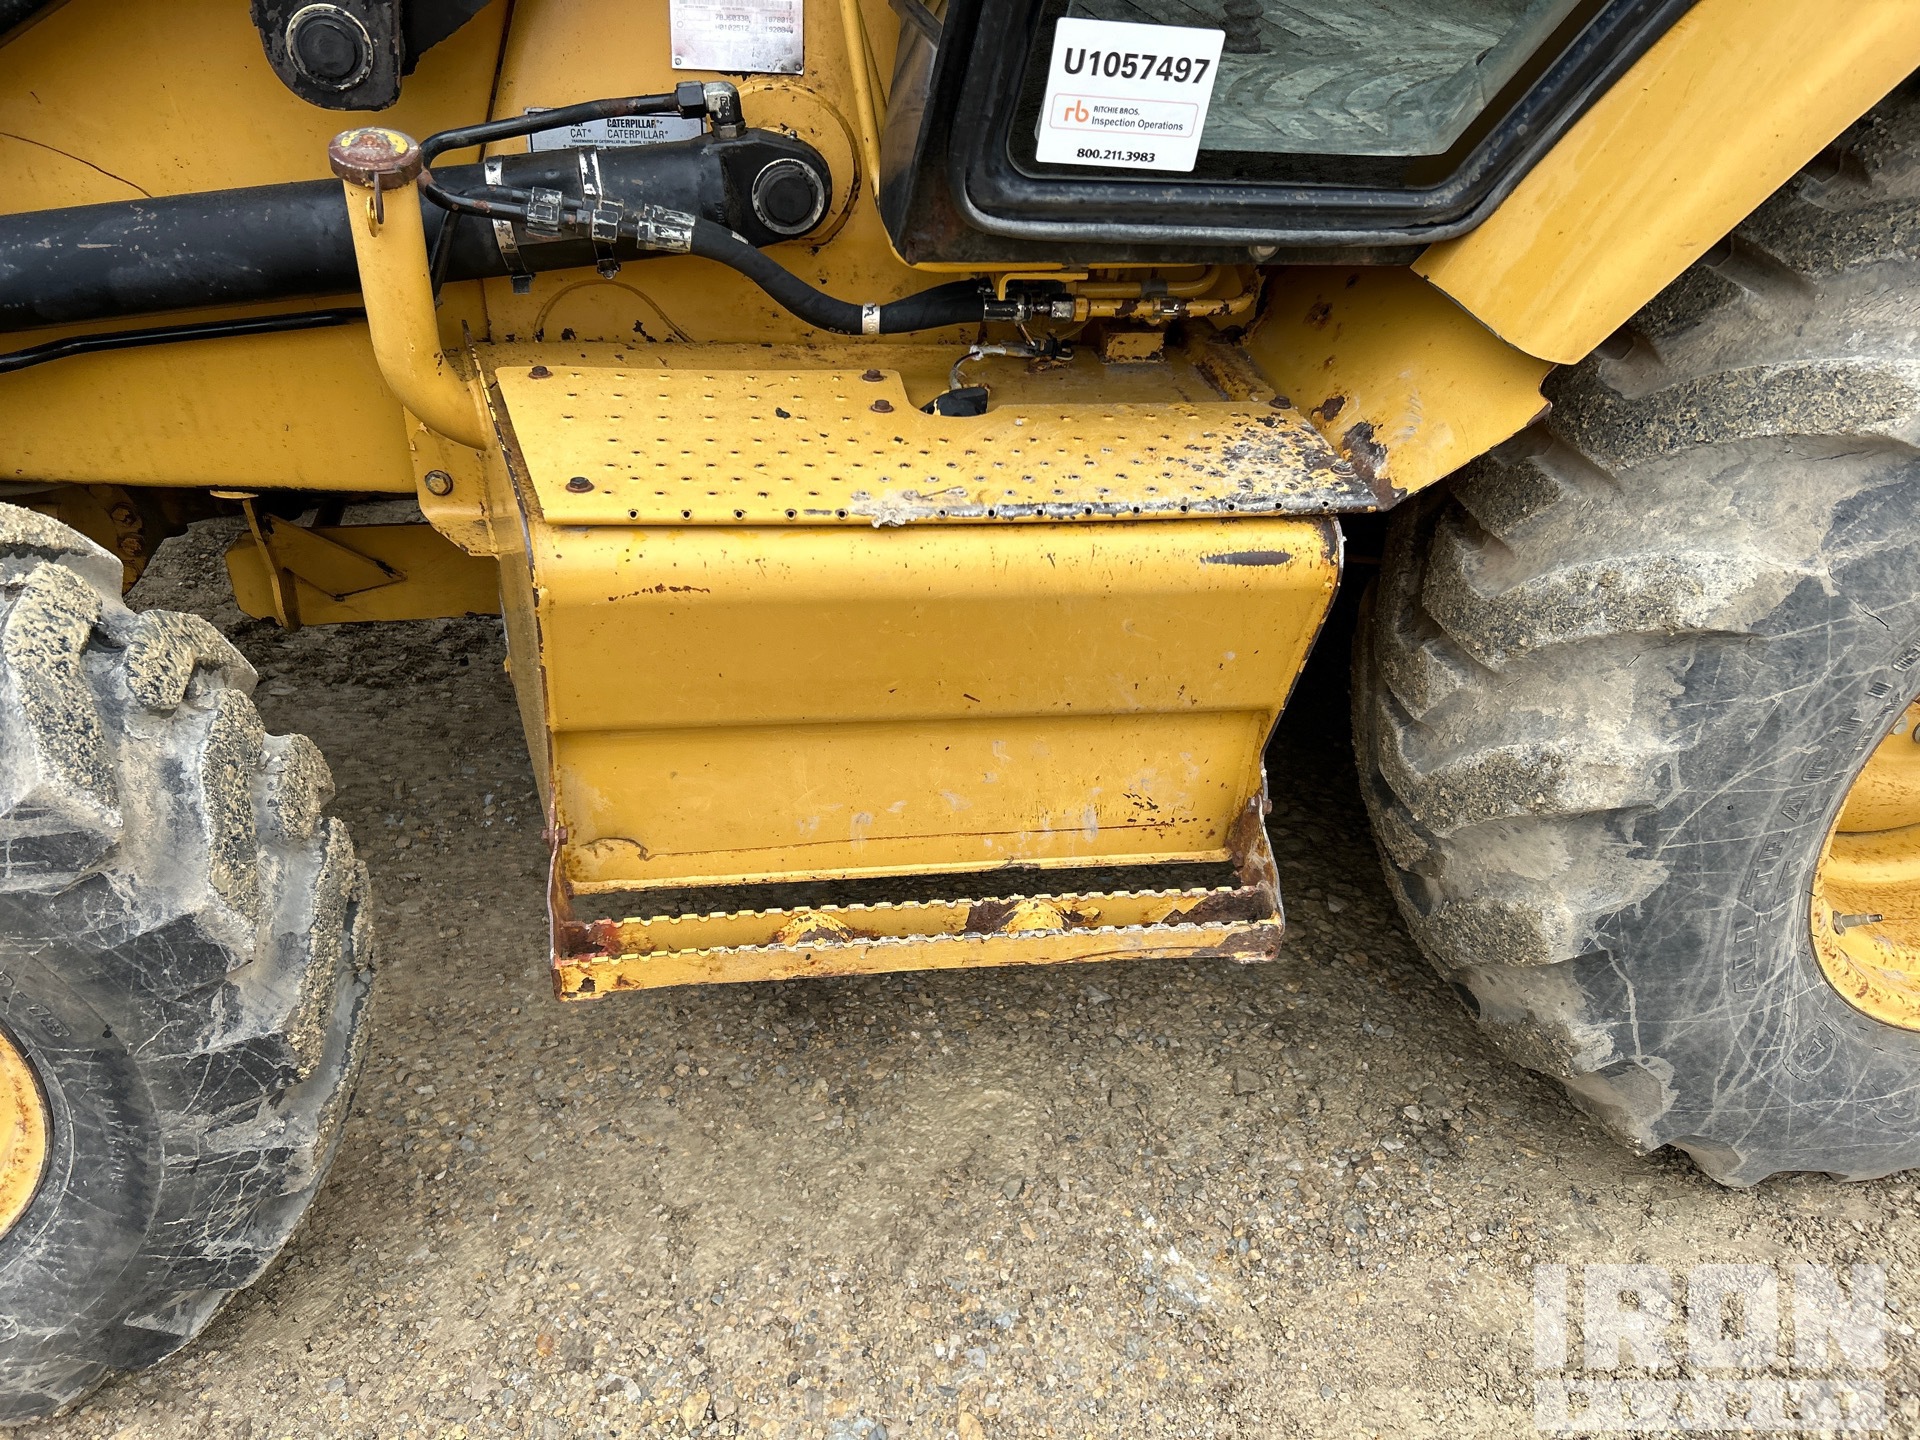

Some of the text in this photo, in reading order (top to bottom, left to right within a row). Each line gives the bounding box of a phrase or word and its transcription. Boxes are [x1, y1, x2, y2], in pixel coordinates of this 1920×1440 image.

[1064, 47, 1211, 84] U1057497
[1064, 100, 1089, 122] rb
[1093, 105, 1140, 115] RITCHIE BROS.
[1091, 116, 1183, 131] Inspection Operations
[1077, 148, 1156, 163] 800.211.3983
